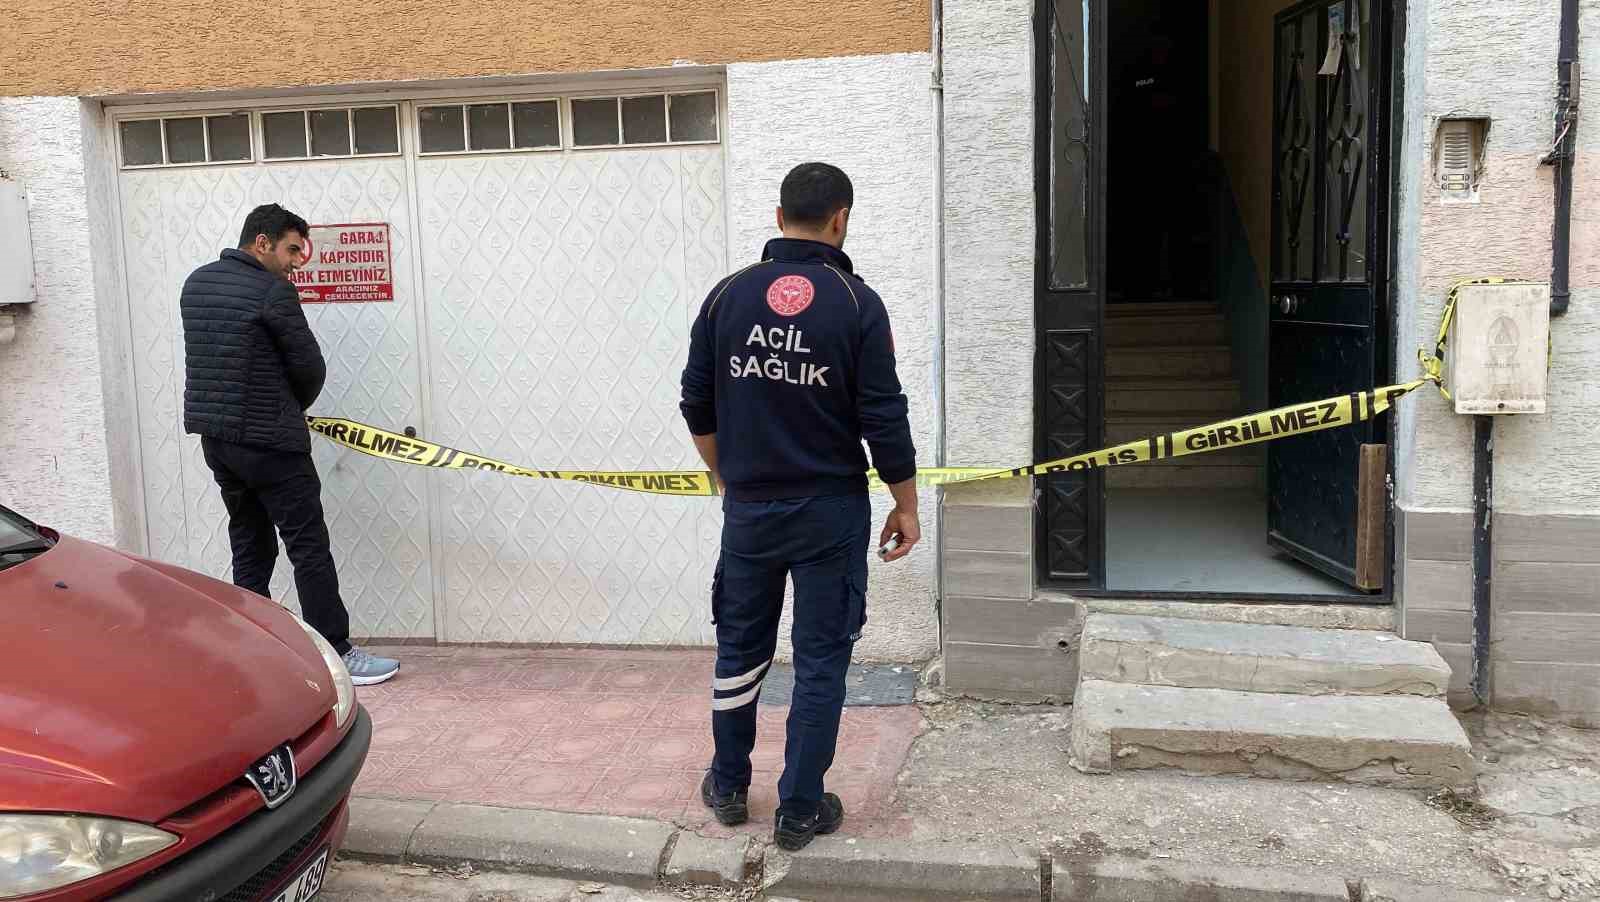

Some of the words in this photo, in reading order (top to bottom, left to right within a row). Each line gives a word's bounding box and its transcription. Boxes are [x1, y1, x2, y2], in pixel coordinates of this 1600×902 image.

[340, 231, 384, 244] GARAJ
[320, 250, 385, 264] KAPISIDIR
[288, 270, 314, 283] ARK
[318, 266, 386, 283] ETMEYİNİZ
[335, 285, 379, 293] ARACINIZ
[746, 324, 811, 353] ACİL
[729, 354, 831, 387] SAĞLIK
